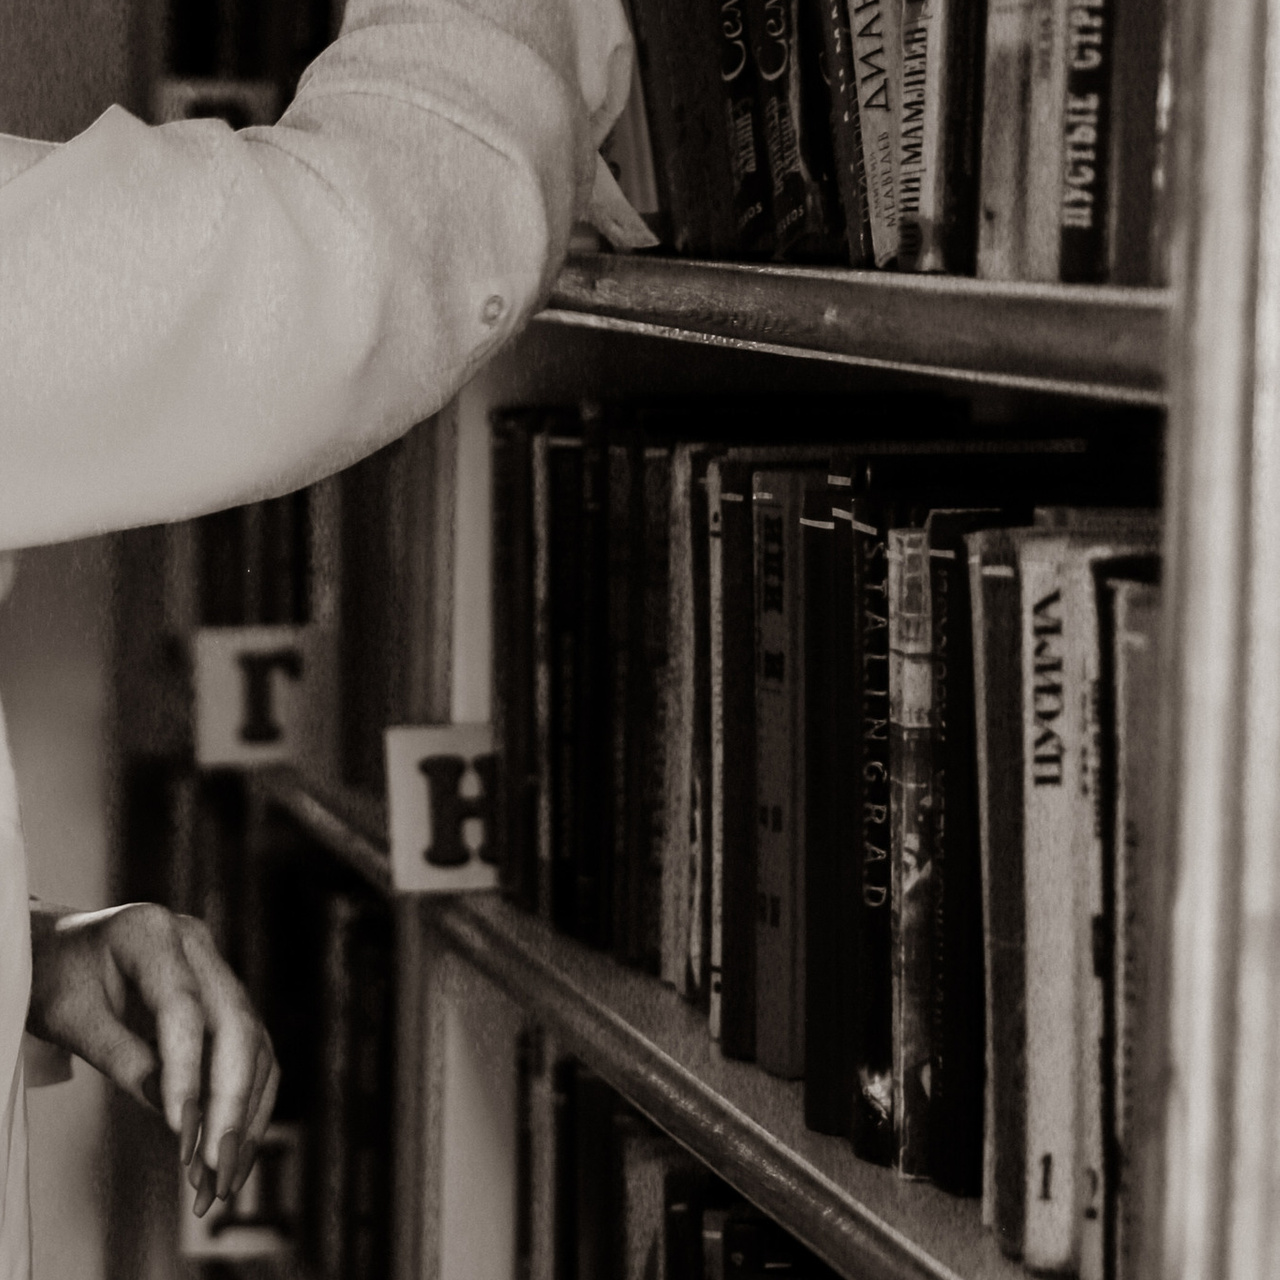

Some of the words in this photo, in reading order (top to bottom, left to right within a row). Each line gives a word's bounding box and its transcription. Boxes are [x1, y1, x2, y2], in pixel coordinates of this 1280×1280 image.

[900, 27, 927, 164] МАМЛЕЕВ
[877, 131, 898, 228] МЕДВЕДЕВ
[1060, 93, 1100, 229] ПУСТЫЕ
[238, 650, 304, 742] Г
[419, 754, 500, 868] Н
